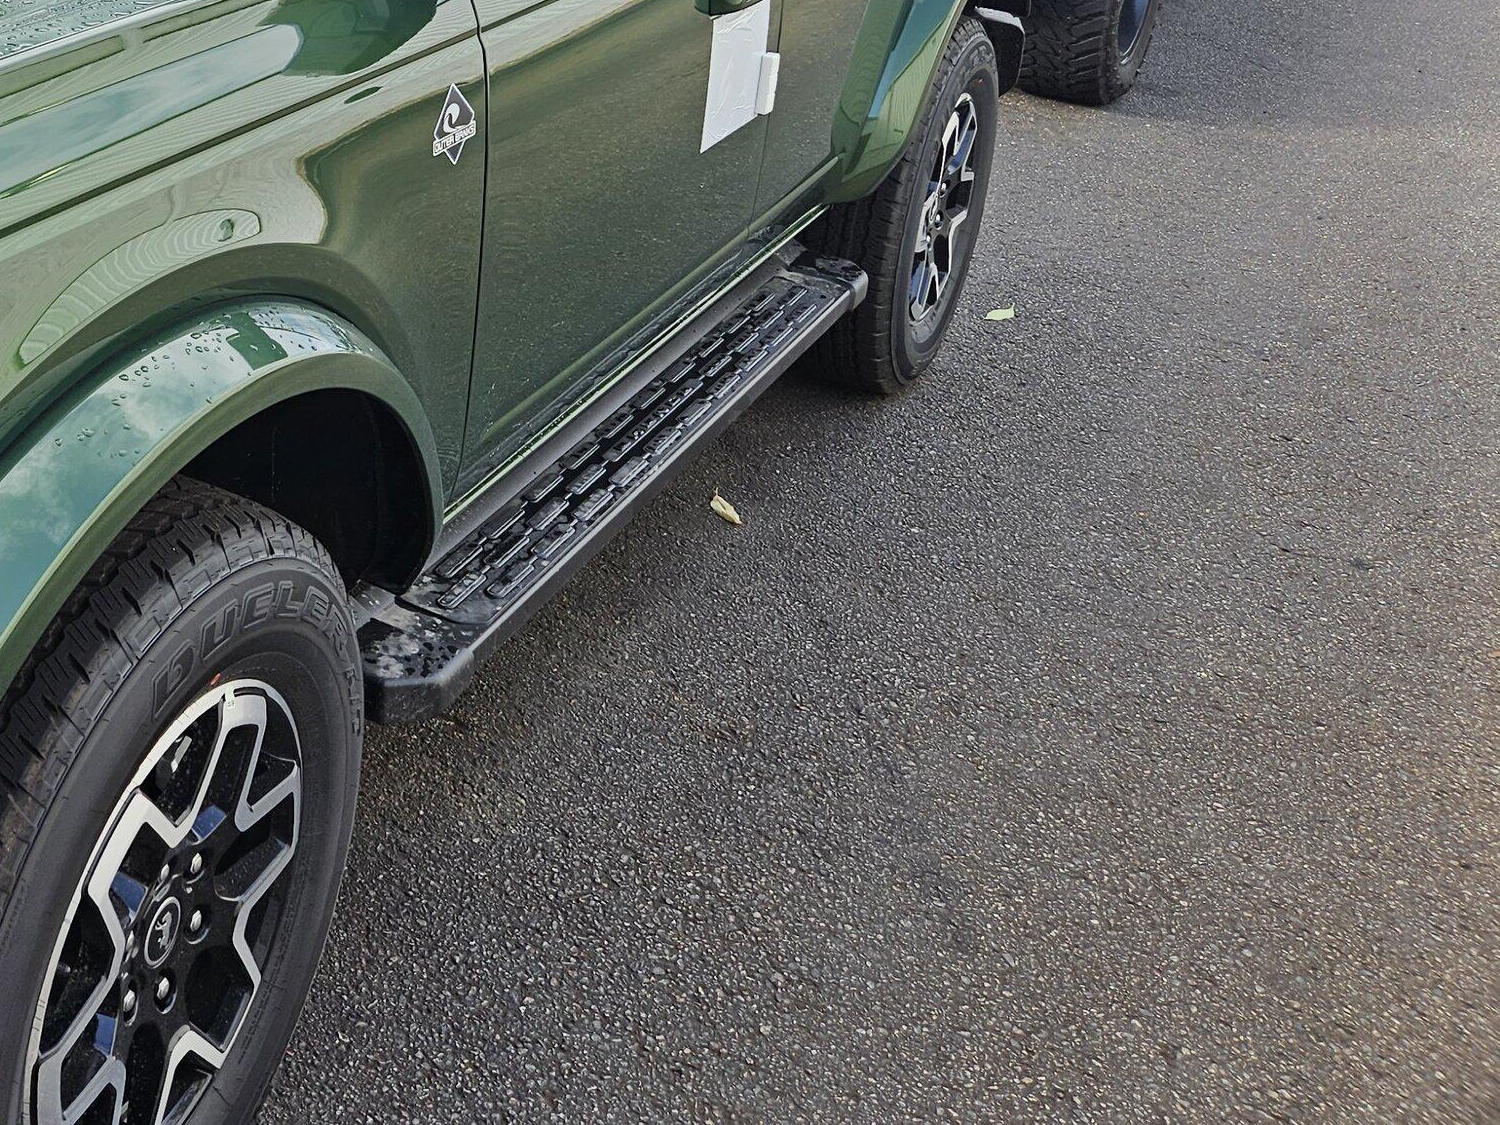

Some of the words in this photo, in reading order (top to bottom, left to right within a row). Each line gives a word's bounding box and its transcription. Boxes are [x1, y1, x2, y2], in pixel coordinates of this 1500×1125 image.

[434, 136, 455, 153] OUTER
[455, 124, 475, 141] BANKS
[153, 580, 348, 722] DUELER
